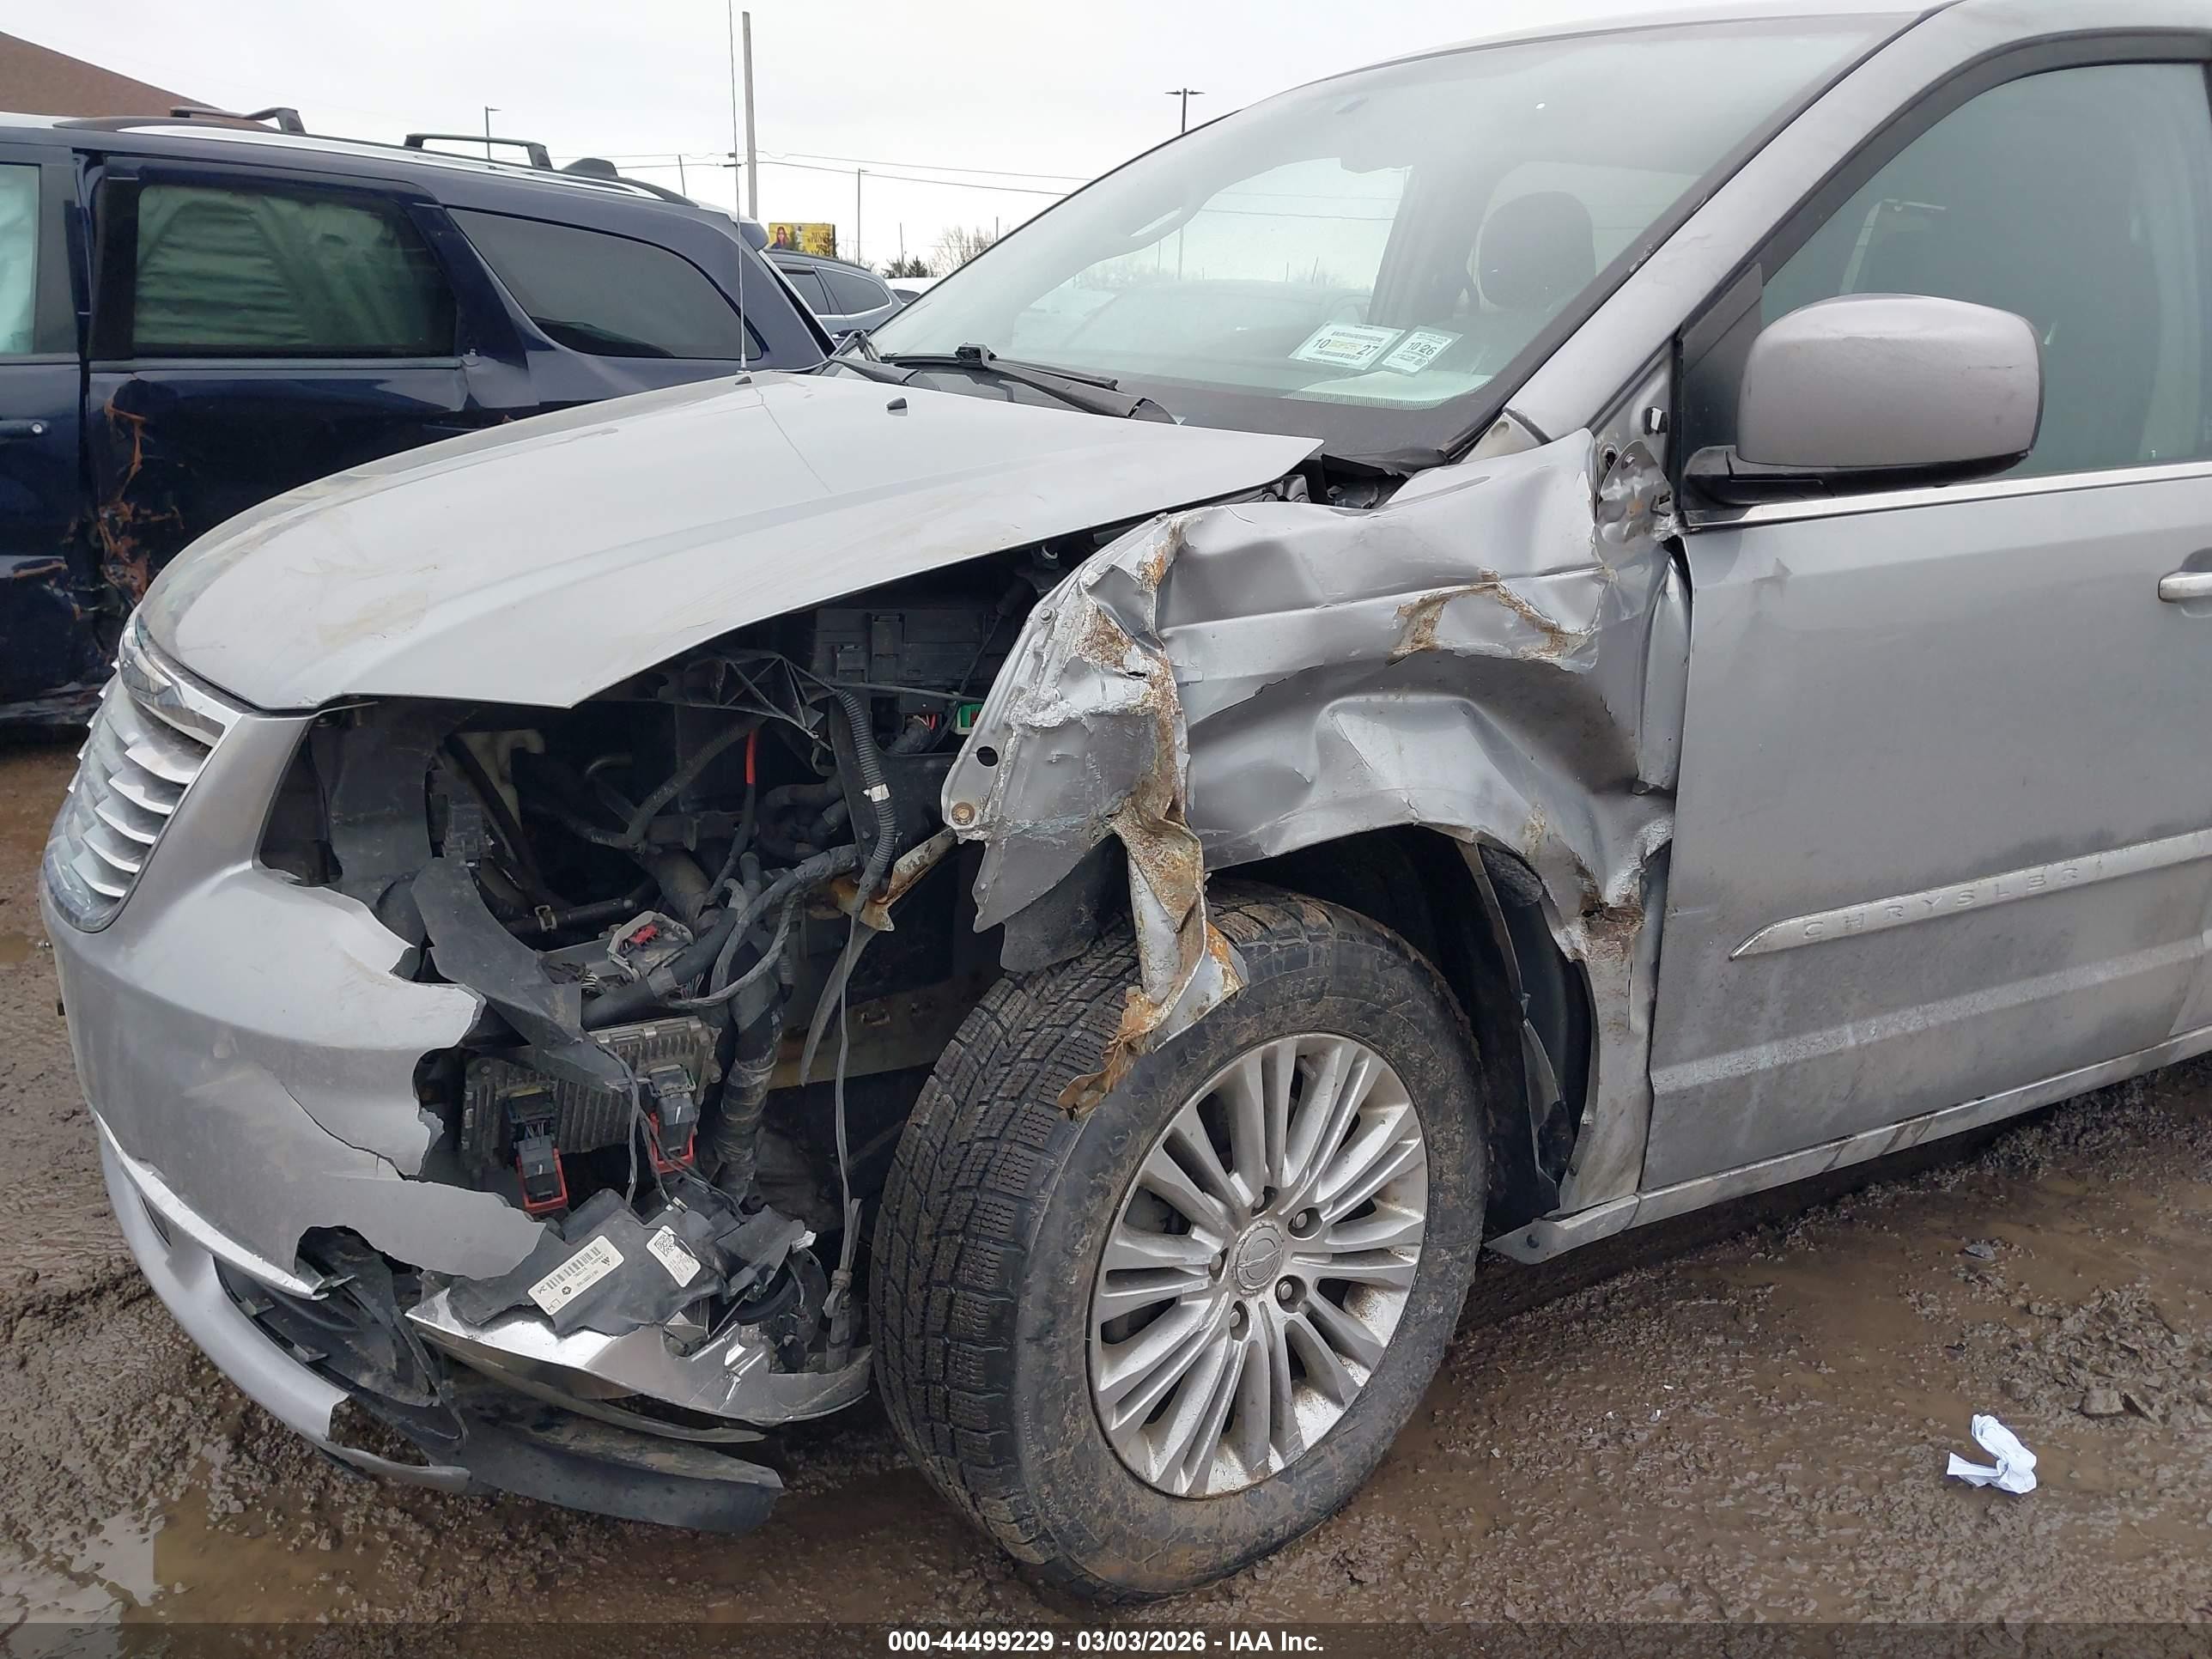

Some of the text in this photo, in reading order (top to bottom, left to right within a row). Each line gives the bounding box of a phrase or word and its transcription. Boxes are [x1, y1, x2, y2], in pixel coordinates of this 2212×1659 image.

[1313, 337, 1332, 349] 10
[1356, 343, 1379, 356] 27
[1406, 342, 1437, 356] 10 26
[1803, 866, 2079, 940] CHRYSLER
